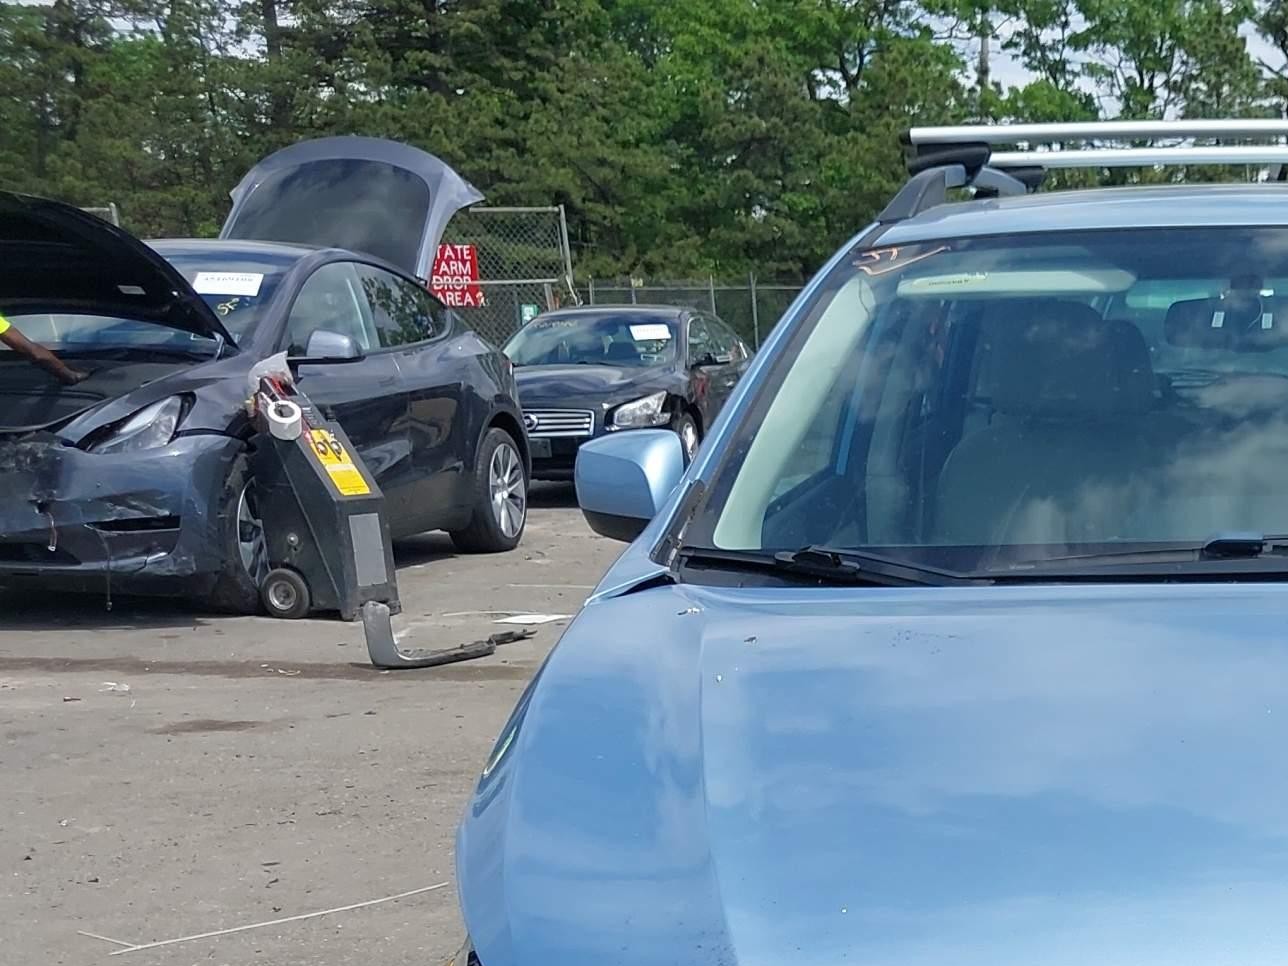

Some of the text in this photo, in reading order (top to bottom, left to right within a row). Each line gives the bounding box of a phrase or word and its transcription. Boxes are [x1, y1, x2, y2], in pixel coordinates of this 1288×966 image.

[436, 244, 472, 260] TATE
[433, 259, 472, 275] ARM
[432, 275, 472, 290] DROP
